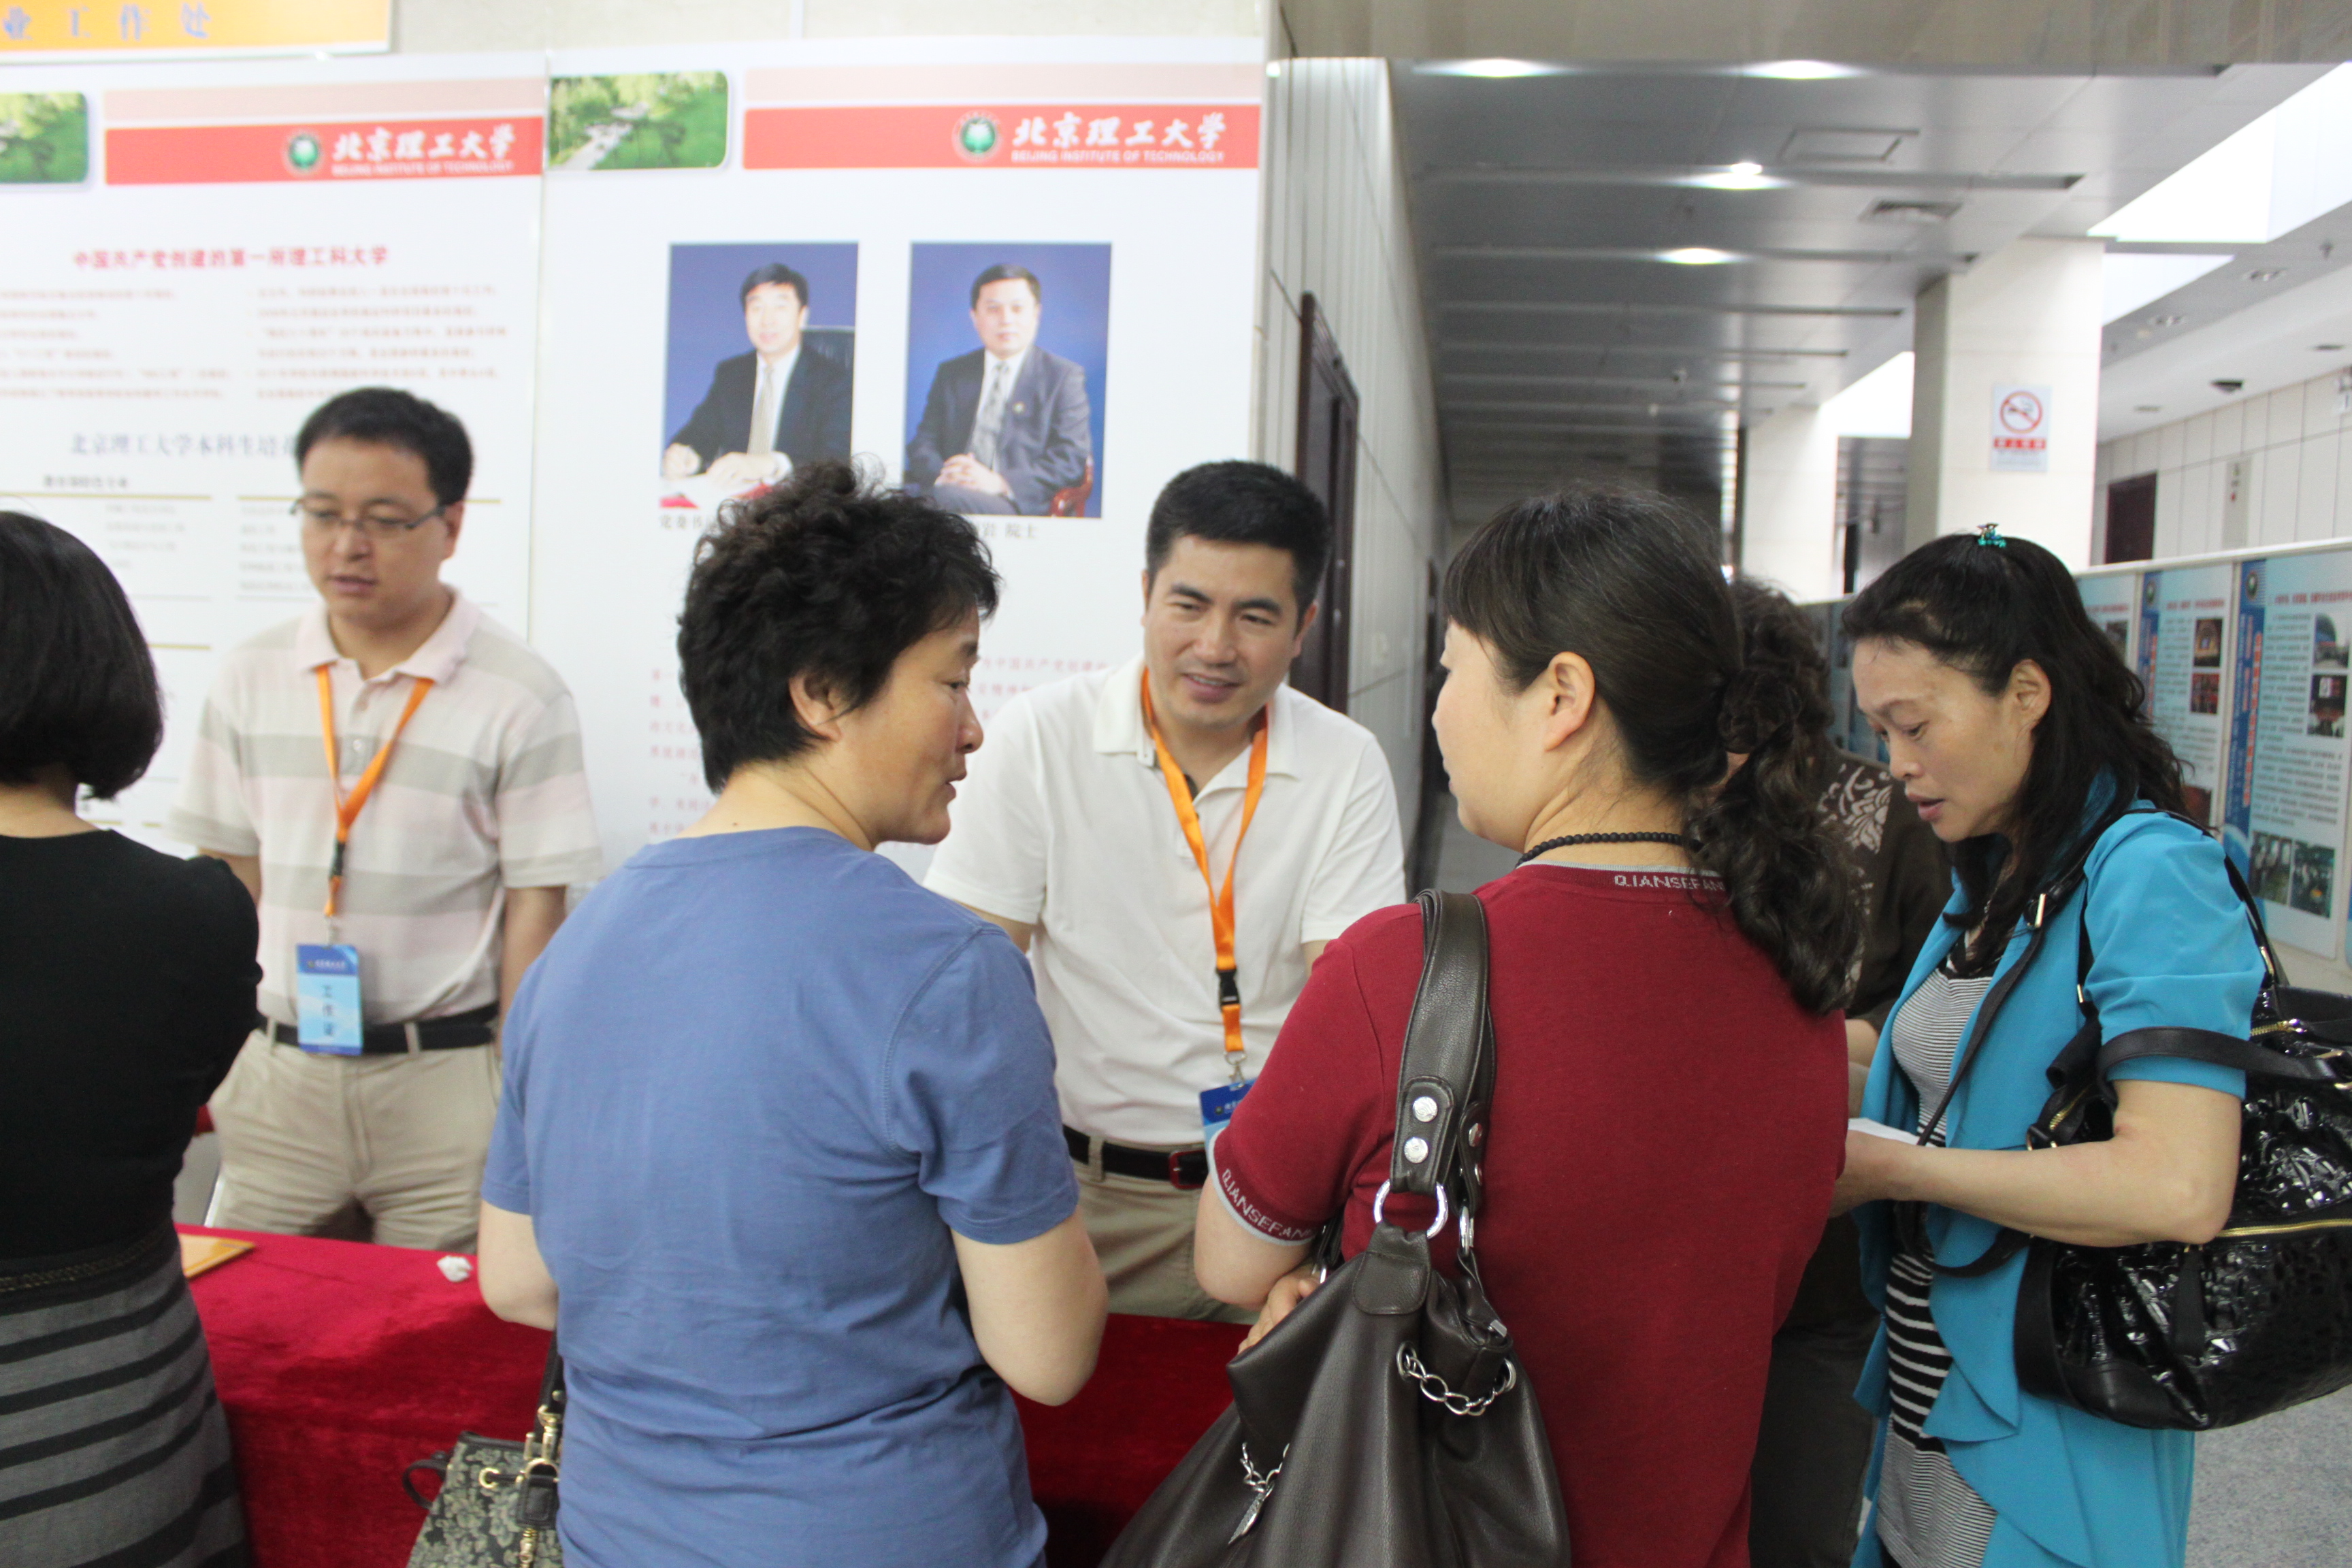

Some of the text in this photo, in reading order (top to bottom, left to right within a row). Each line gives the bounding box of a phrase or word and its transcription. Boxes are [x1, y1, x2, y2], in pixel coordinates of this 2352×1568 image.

[332, 123, 517, 162] 北京理工大学
[1012, 111, 1226, 149] 北京理工大学
[1011, 150, 1226, 164] BEIJING INSTITUTE OF TECHNOLOGY
